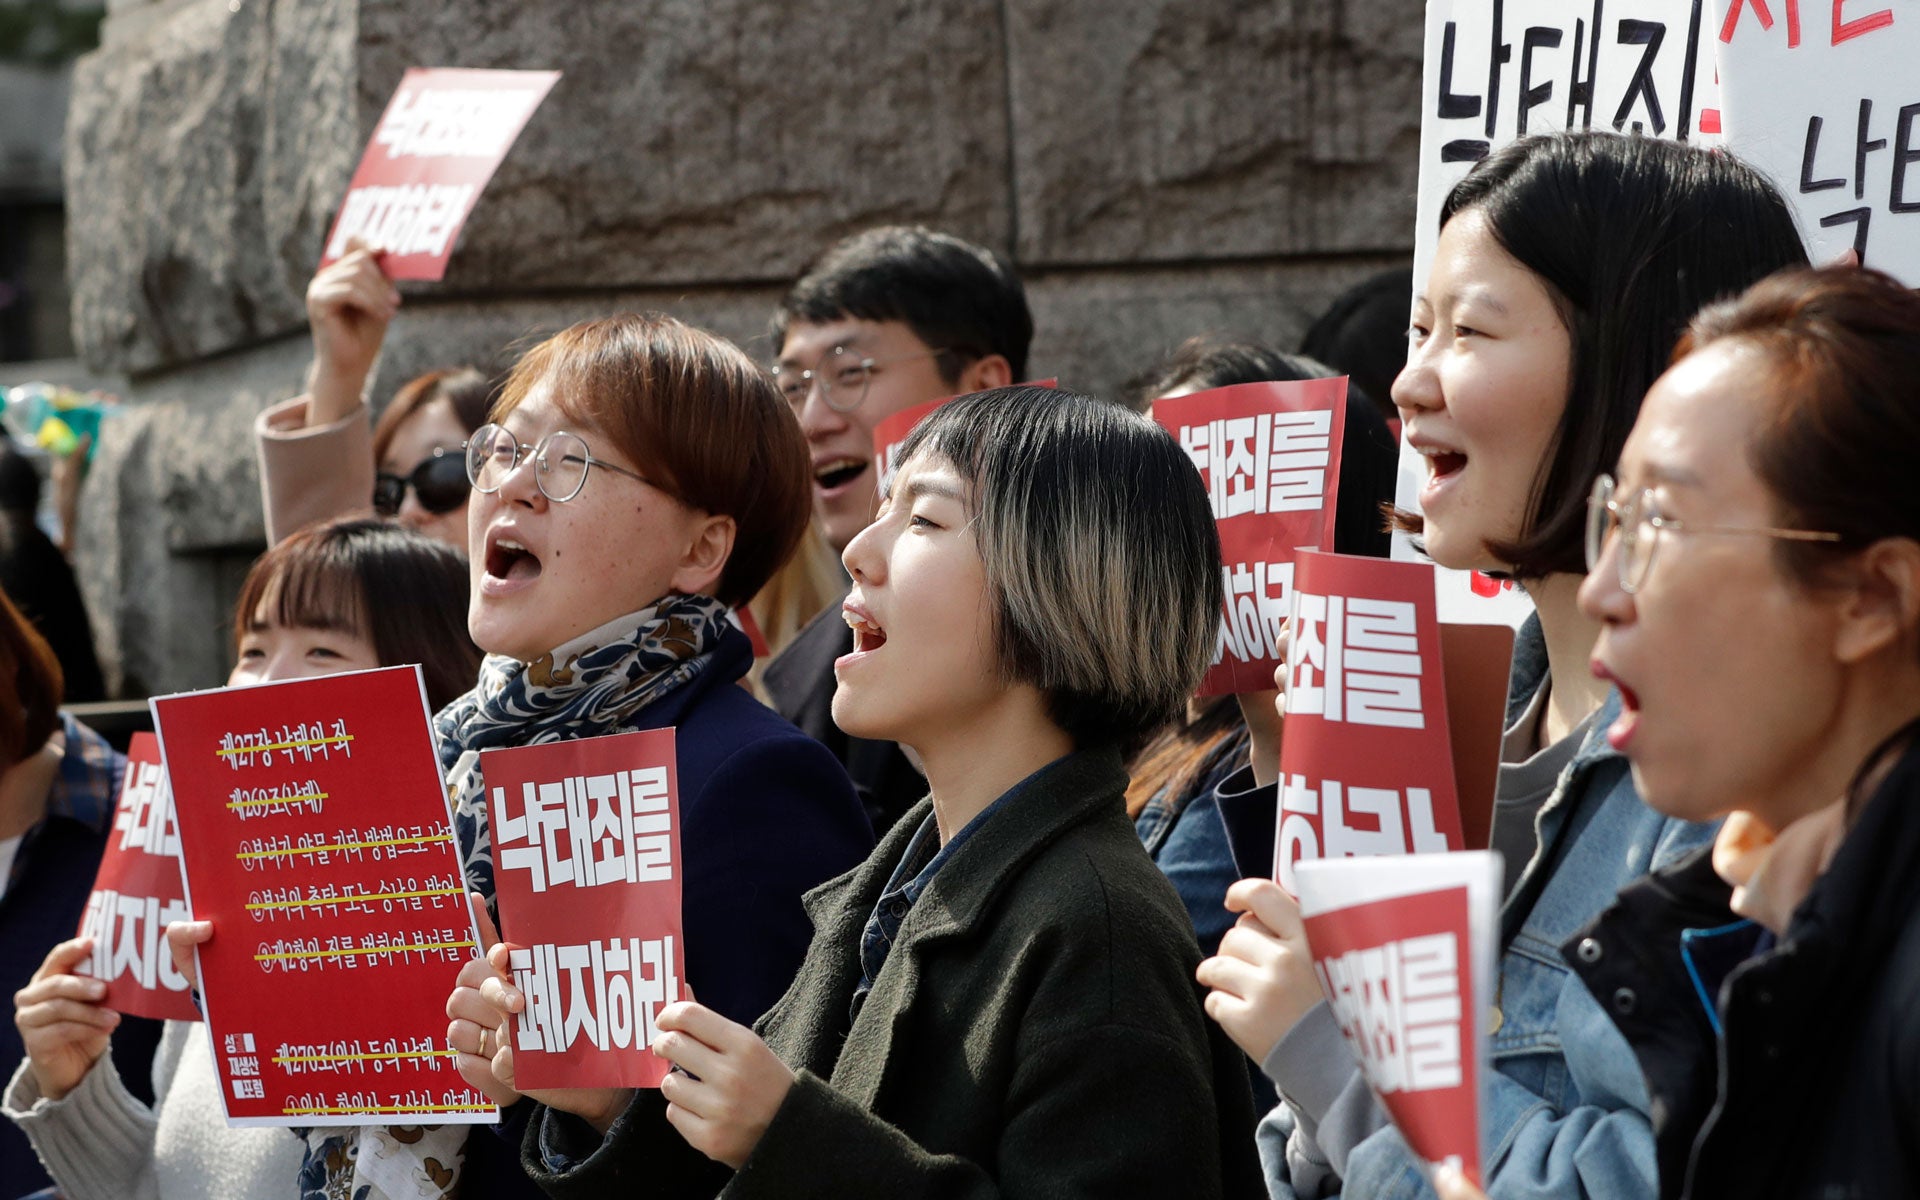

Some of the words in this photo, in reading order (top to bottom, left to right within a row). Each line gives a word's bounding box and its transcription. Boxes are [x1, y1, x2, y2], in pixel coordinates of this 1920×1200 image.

[1179, 409, 1332, 520] 태죄를
[1285, 590, 1425, 729] 죄를
[219, 728, 272, 771] 제27장
[275, 721, 328, 764] 낙태의
[331, 718, 351, 758] 죄
[229, 779, 323, 821] 제269조(낙태)
[298, 832, 330, 866] 약물
[364, 825, 428, 860] 방법으로
[493, 766, 672, 892] 낙태죄를
[308, 883, 338, 918] 촉탁
[378, 877, 423, 913] 승낙을
[325, 935, 357, 970] 죄를
[360, 931, 409, 967] 범하여
[411, 929, 459, 964] 부녀를
[509, 935, 678, 1053] 폐지하라
[368, 1038, 400, 1073] 등의
